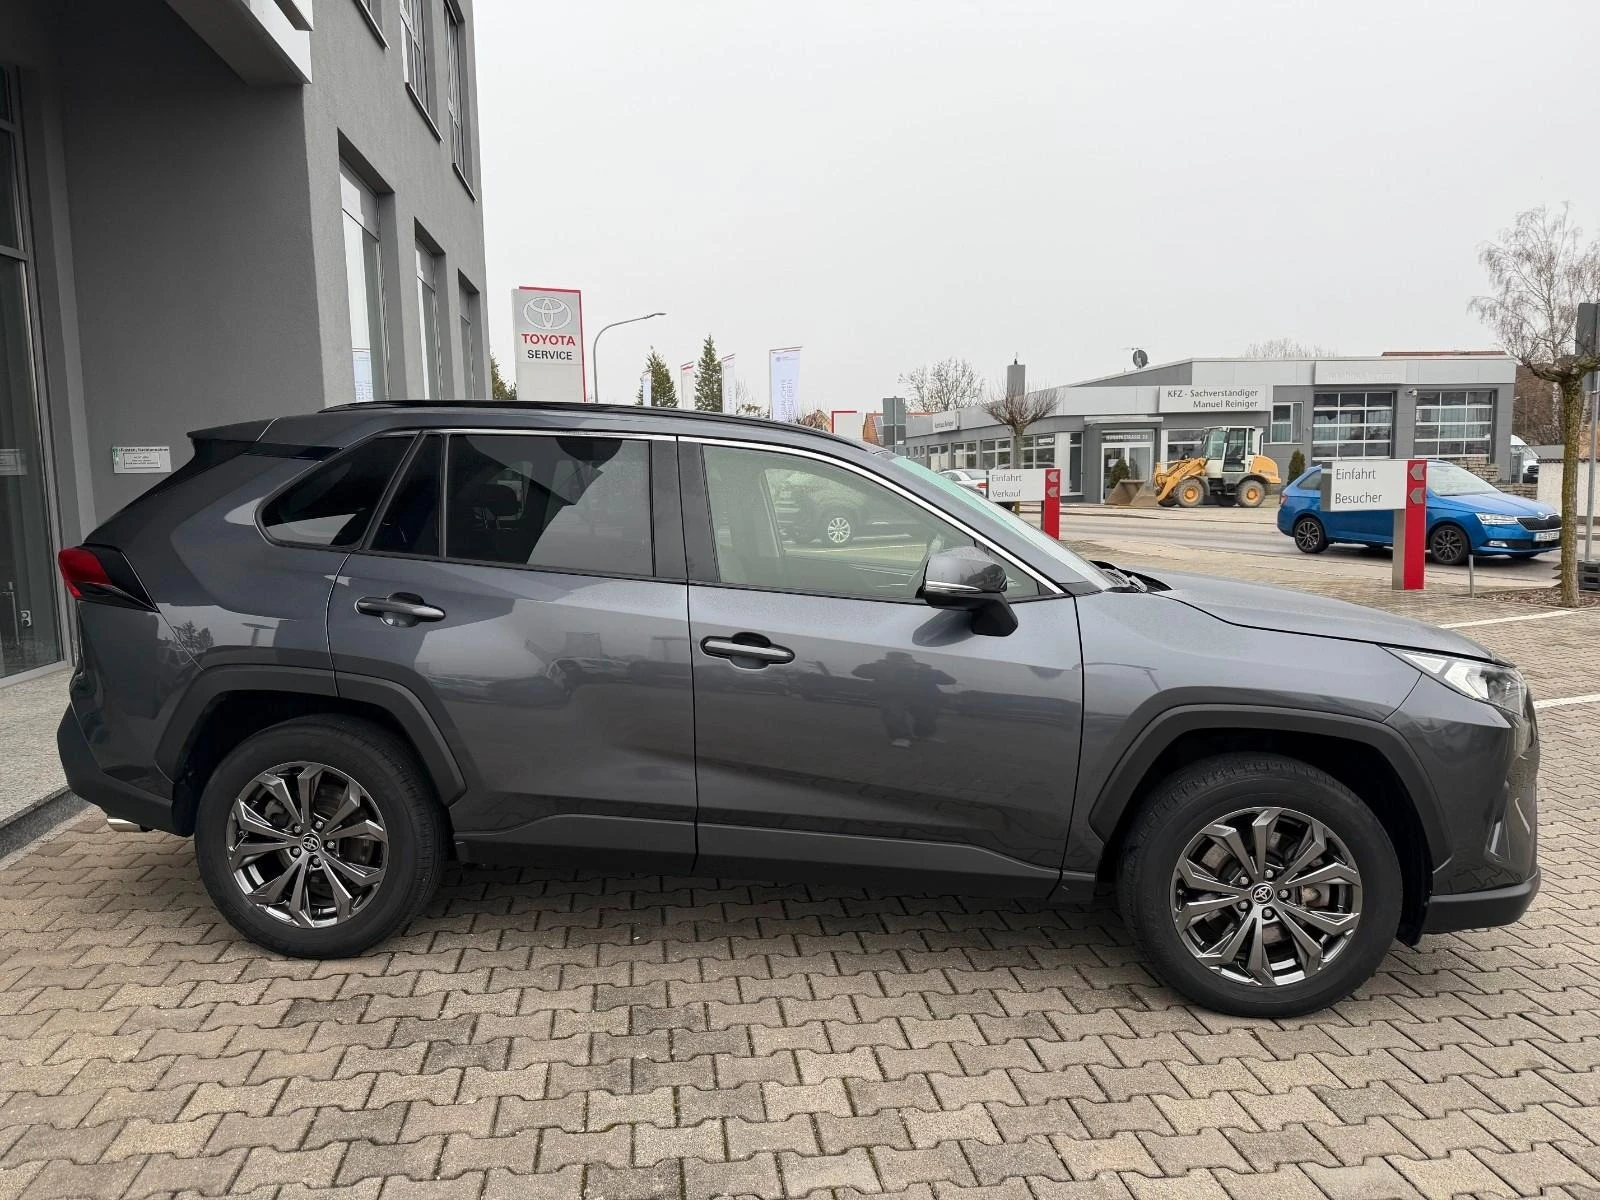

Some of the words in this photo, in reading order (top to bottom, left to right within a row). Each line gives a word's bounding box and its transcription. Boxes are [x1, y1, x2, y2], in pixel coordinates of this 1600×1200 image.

[521, 333, 576, 346] TOYOTA
[527, 349, 573, 361] SERVICE
[1167, 389, 1183, 398] KFZ
[1190, 388, 1259, 399] Sachverständiger
[1193, 400, 1223, 408] Manuel
[1225, 400, 1259, 410] Reiniger
[991, 473, 1023, 482] Einfahrt
[1335, 467, 1377, 480] Einfahrt
[1334, 491, 1383, 505] Besucher
